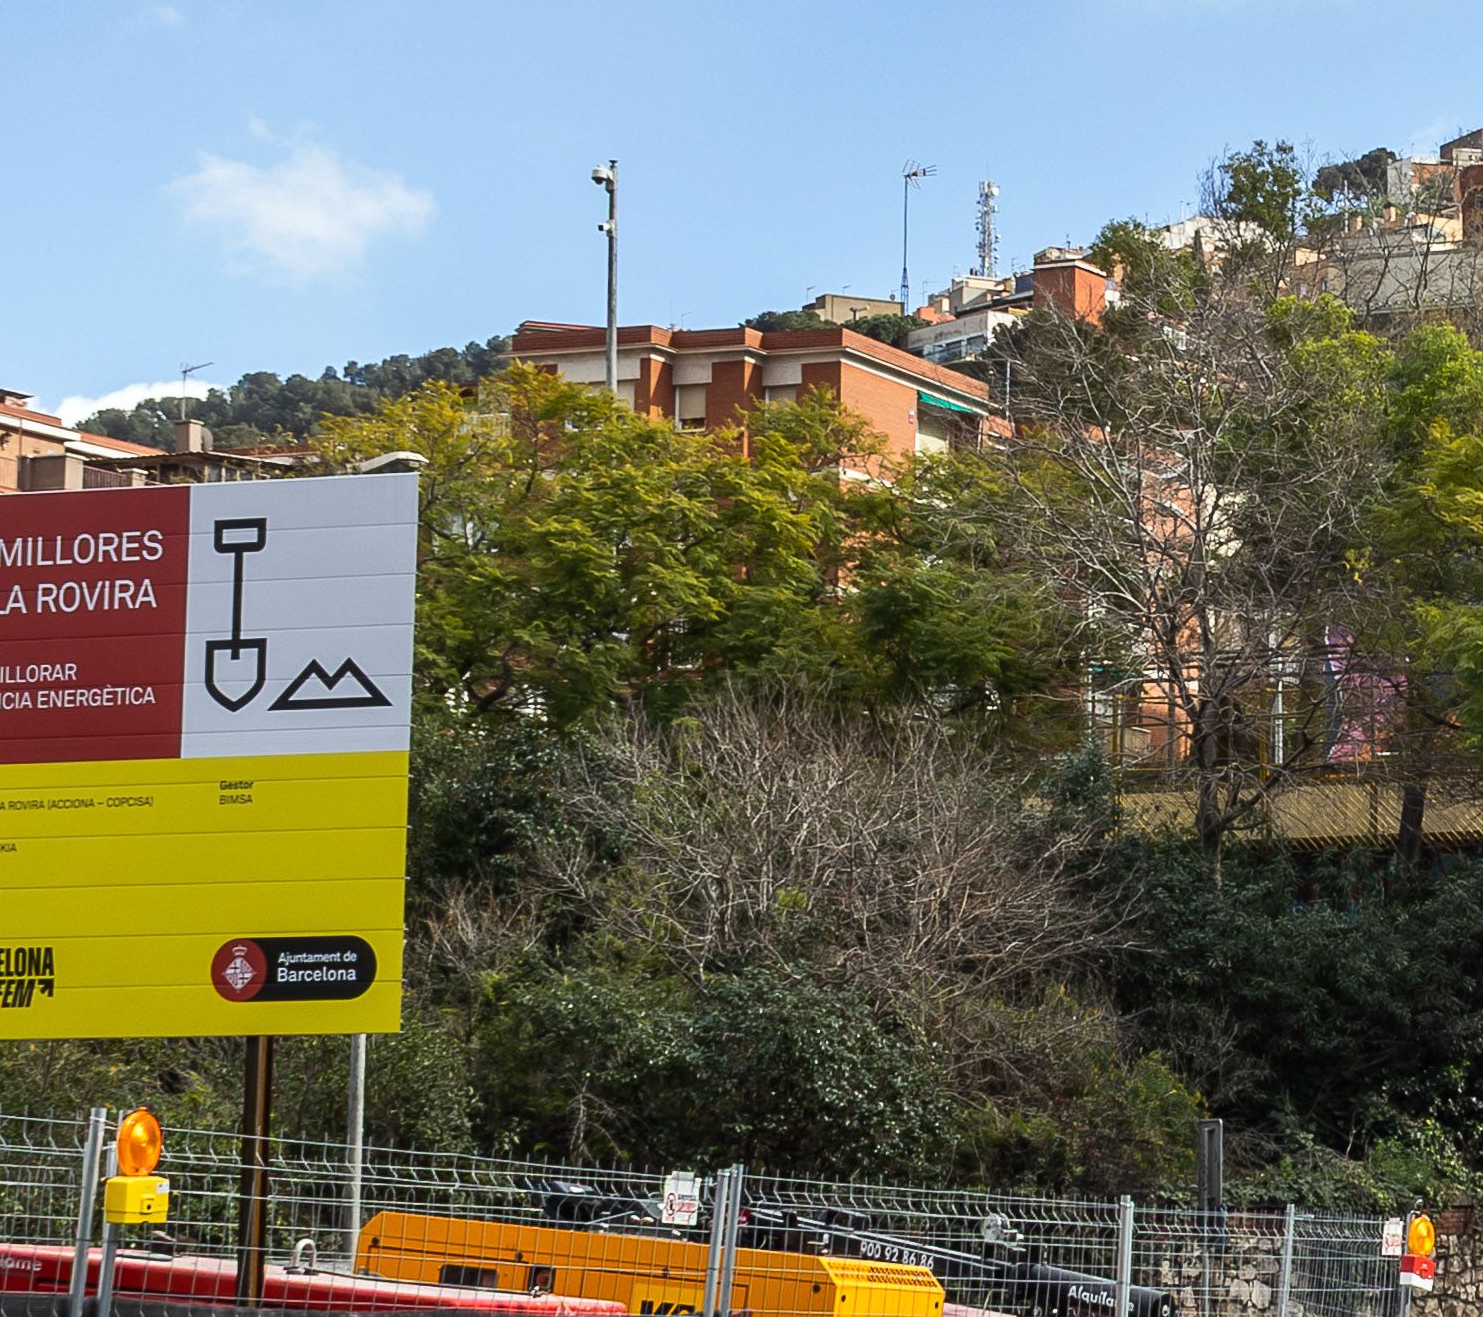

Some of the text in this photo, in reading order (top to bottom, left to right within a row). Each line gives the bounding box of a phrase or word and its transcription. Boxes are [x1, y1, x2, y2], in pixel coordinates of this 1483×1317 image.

[36, 578, 158, 614] ROVIRA
[36, 683, 157, 710] ENERGÈTICA
[219, 780, 255, 791] Gestor
[8, 800, 45, 811] ROVIRA
[47, 797, 95, 810] (ACCIONA
[106, 796, 154, 809] COPCISA)
[219, 794, 253, 806] BIMSA
[277, 950, 358, 966] Ajuntament de
[277, 966, 358, 982] Barcelona
[860, 1242, 882, 1259] 900
[884, 1246, 899, 1262] 92
[902, 1249, 916, 1266] 86
[1067, 1285, 1135, 1312] Alquilae
